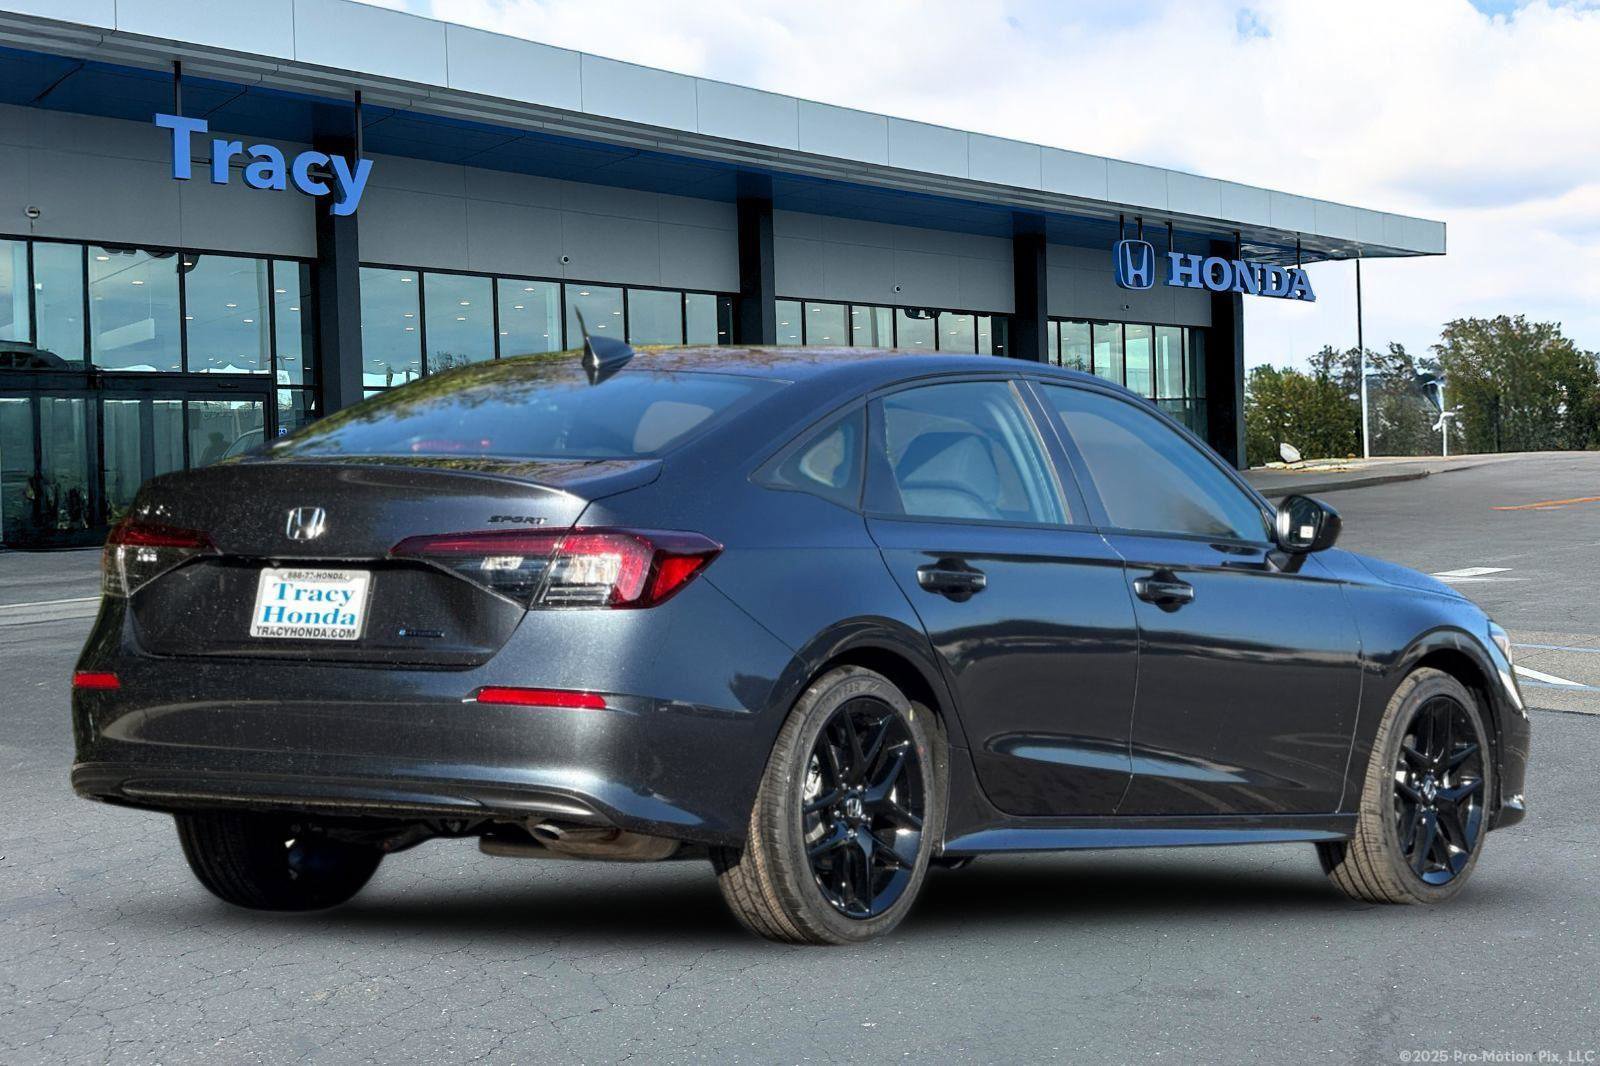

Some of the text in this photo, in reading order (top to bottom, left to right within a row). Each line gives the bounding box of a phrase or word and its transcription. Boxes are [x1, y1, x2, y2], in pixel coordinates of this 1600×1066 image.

[154, 113, 374, 216] Tracy
[1166, 251, 1317, 302] HONDA
[487, 515, 548, 525] SPORT
[273, 582, 356, 607] Tracy
[262, 605, 357, 626] Honda
[256, 626, 356, 638] TRACYHONDA.COM
